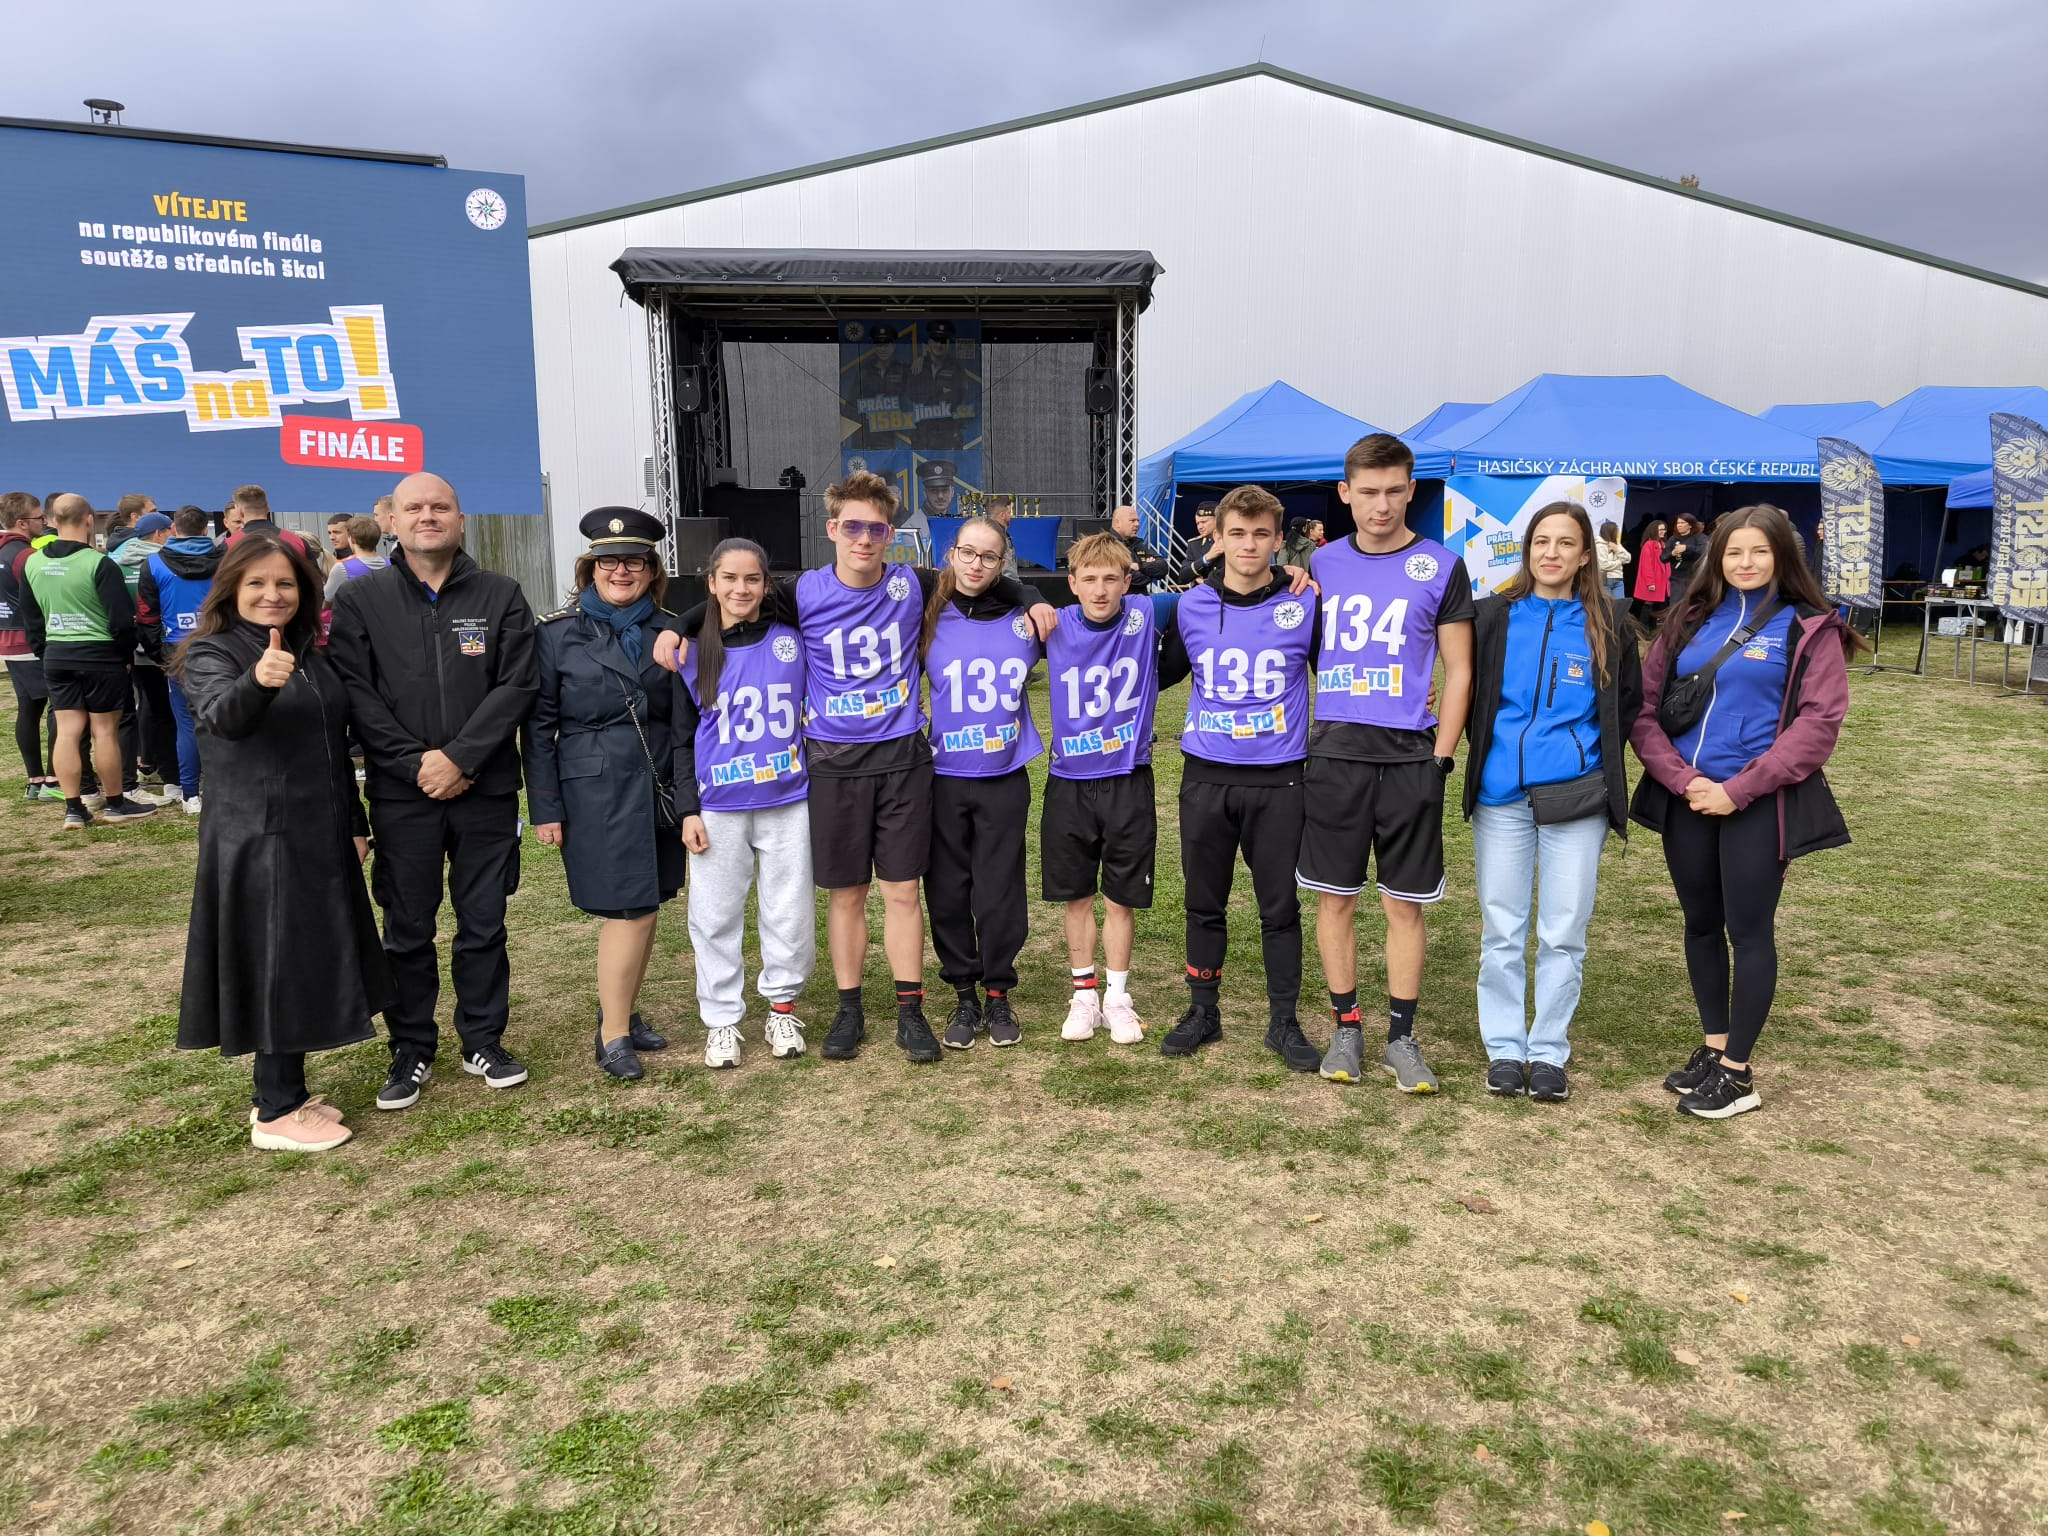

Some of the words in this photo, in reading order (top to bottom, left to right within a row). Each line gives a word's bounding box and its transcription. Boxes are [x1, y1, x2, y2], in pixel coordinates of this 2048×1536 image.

[153, 192, 248, 222] VÍTEJTE
[79, 222, 105, 239] na
[112, 223, 257, 249] republikovém
[263, 231, 322, 254] finále
[80, 248, 168, 270] soutěže
[175, 252, 275, 277] středních
[282, 258, 325, 280] škol
[8, 324, 186, 410] MÁŠ
[193, 379, 270, 421] na
[251, 316, 388, 411] TO!
[300, 427, 405, 463] FINÁLE
[1477, 457, 1555, 475] HASIČSKÝ
[1559, 458, 1658, 475] ZÁCHRANNÝ
[1663, 461, 1704, 476] SBOR
[1708, 458, 1756, 476] ČESKÉ
[1487, 531, 1512, 545] PRÁCE
[1322, 594, 1408, 656] 134
[823, 622, 902, 680] 131
[943, 657, 1027, 713] 133
[1060, 657, 1141, 719] 132
[1198, 648, 1287, 701] 136
[1318, 666, 1352, 690] MÁŠ
[1352, 681, 1368, 694] na
[1366, 666, 1401, 694] TO!
[713, 683, 795, 744] 135
[828, 693, 864, 714] MÁŠ
[1201, 712, 1233, 732] MÁŠ
[1250, 705, 1284, 732] TO!
[945, 726, 984, 750] MÁŠ
[985, 738, 1003, 751] na
[1064, 730, 1103, 754] MÁŠ
[1103, 738, 1121, 752] na
[713, 757, 754, 784] MÁŠ
[755, 767, 775, 783] na
[769, 745, 800, 772] TO!
